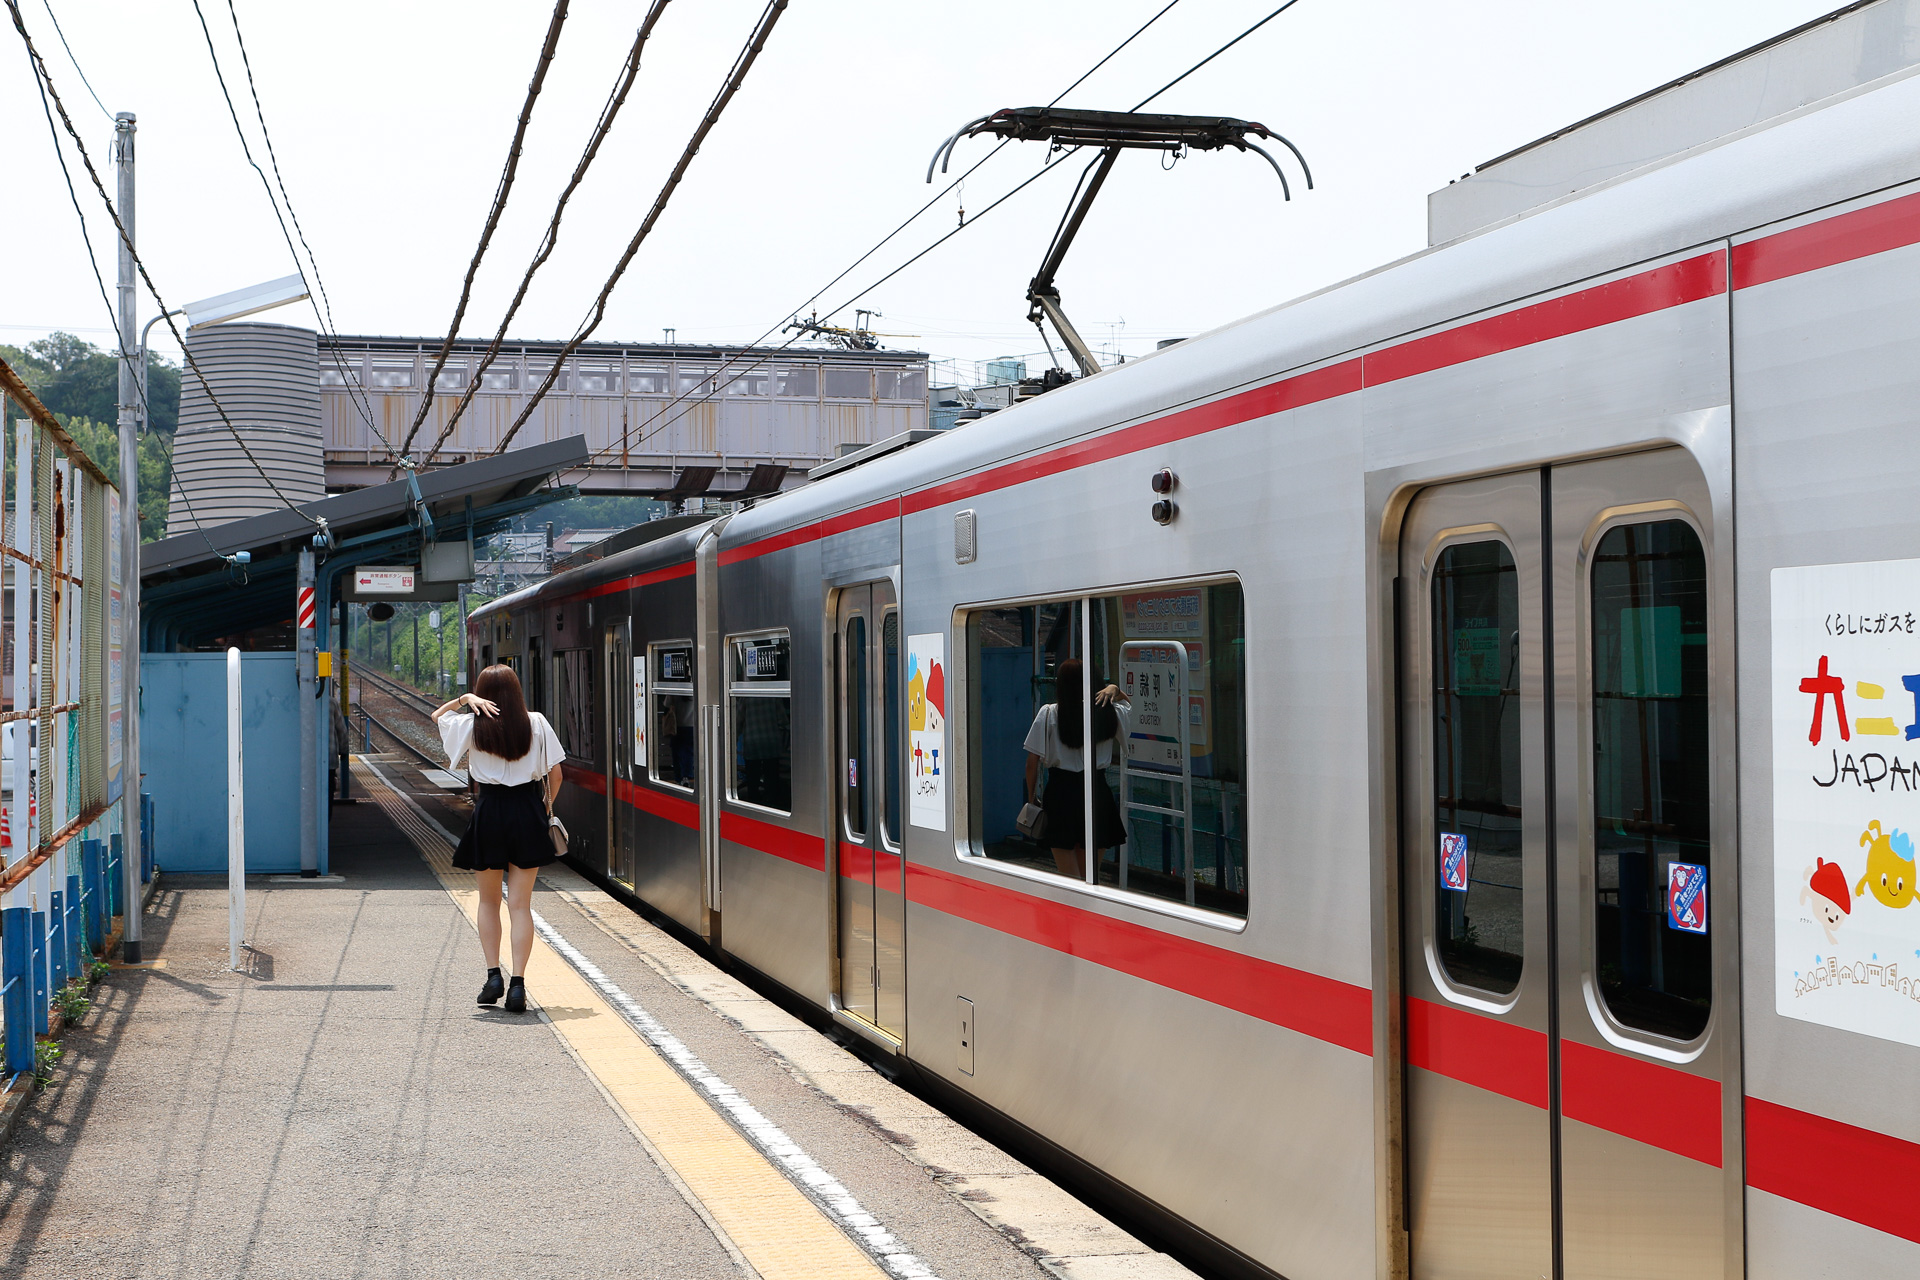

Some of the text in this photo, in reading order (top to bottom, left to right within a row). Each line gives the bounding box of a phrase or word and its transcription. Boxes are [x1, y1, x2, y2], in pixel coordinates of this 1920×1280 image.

[1824, 611, 1916, 636] くらしにガスを
[1458, 638, 1470, 651] 500
[914, 740, 940, 778] カニエ
[916, 778, 940, 798] JAPAN
